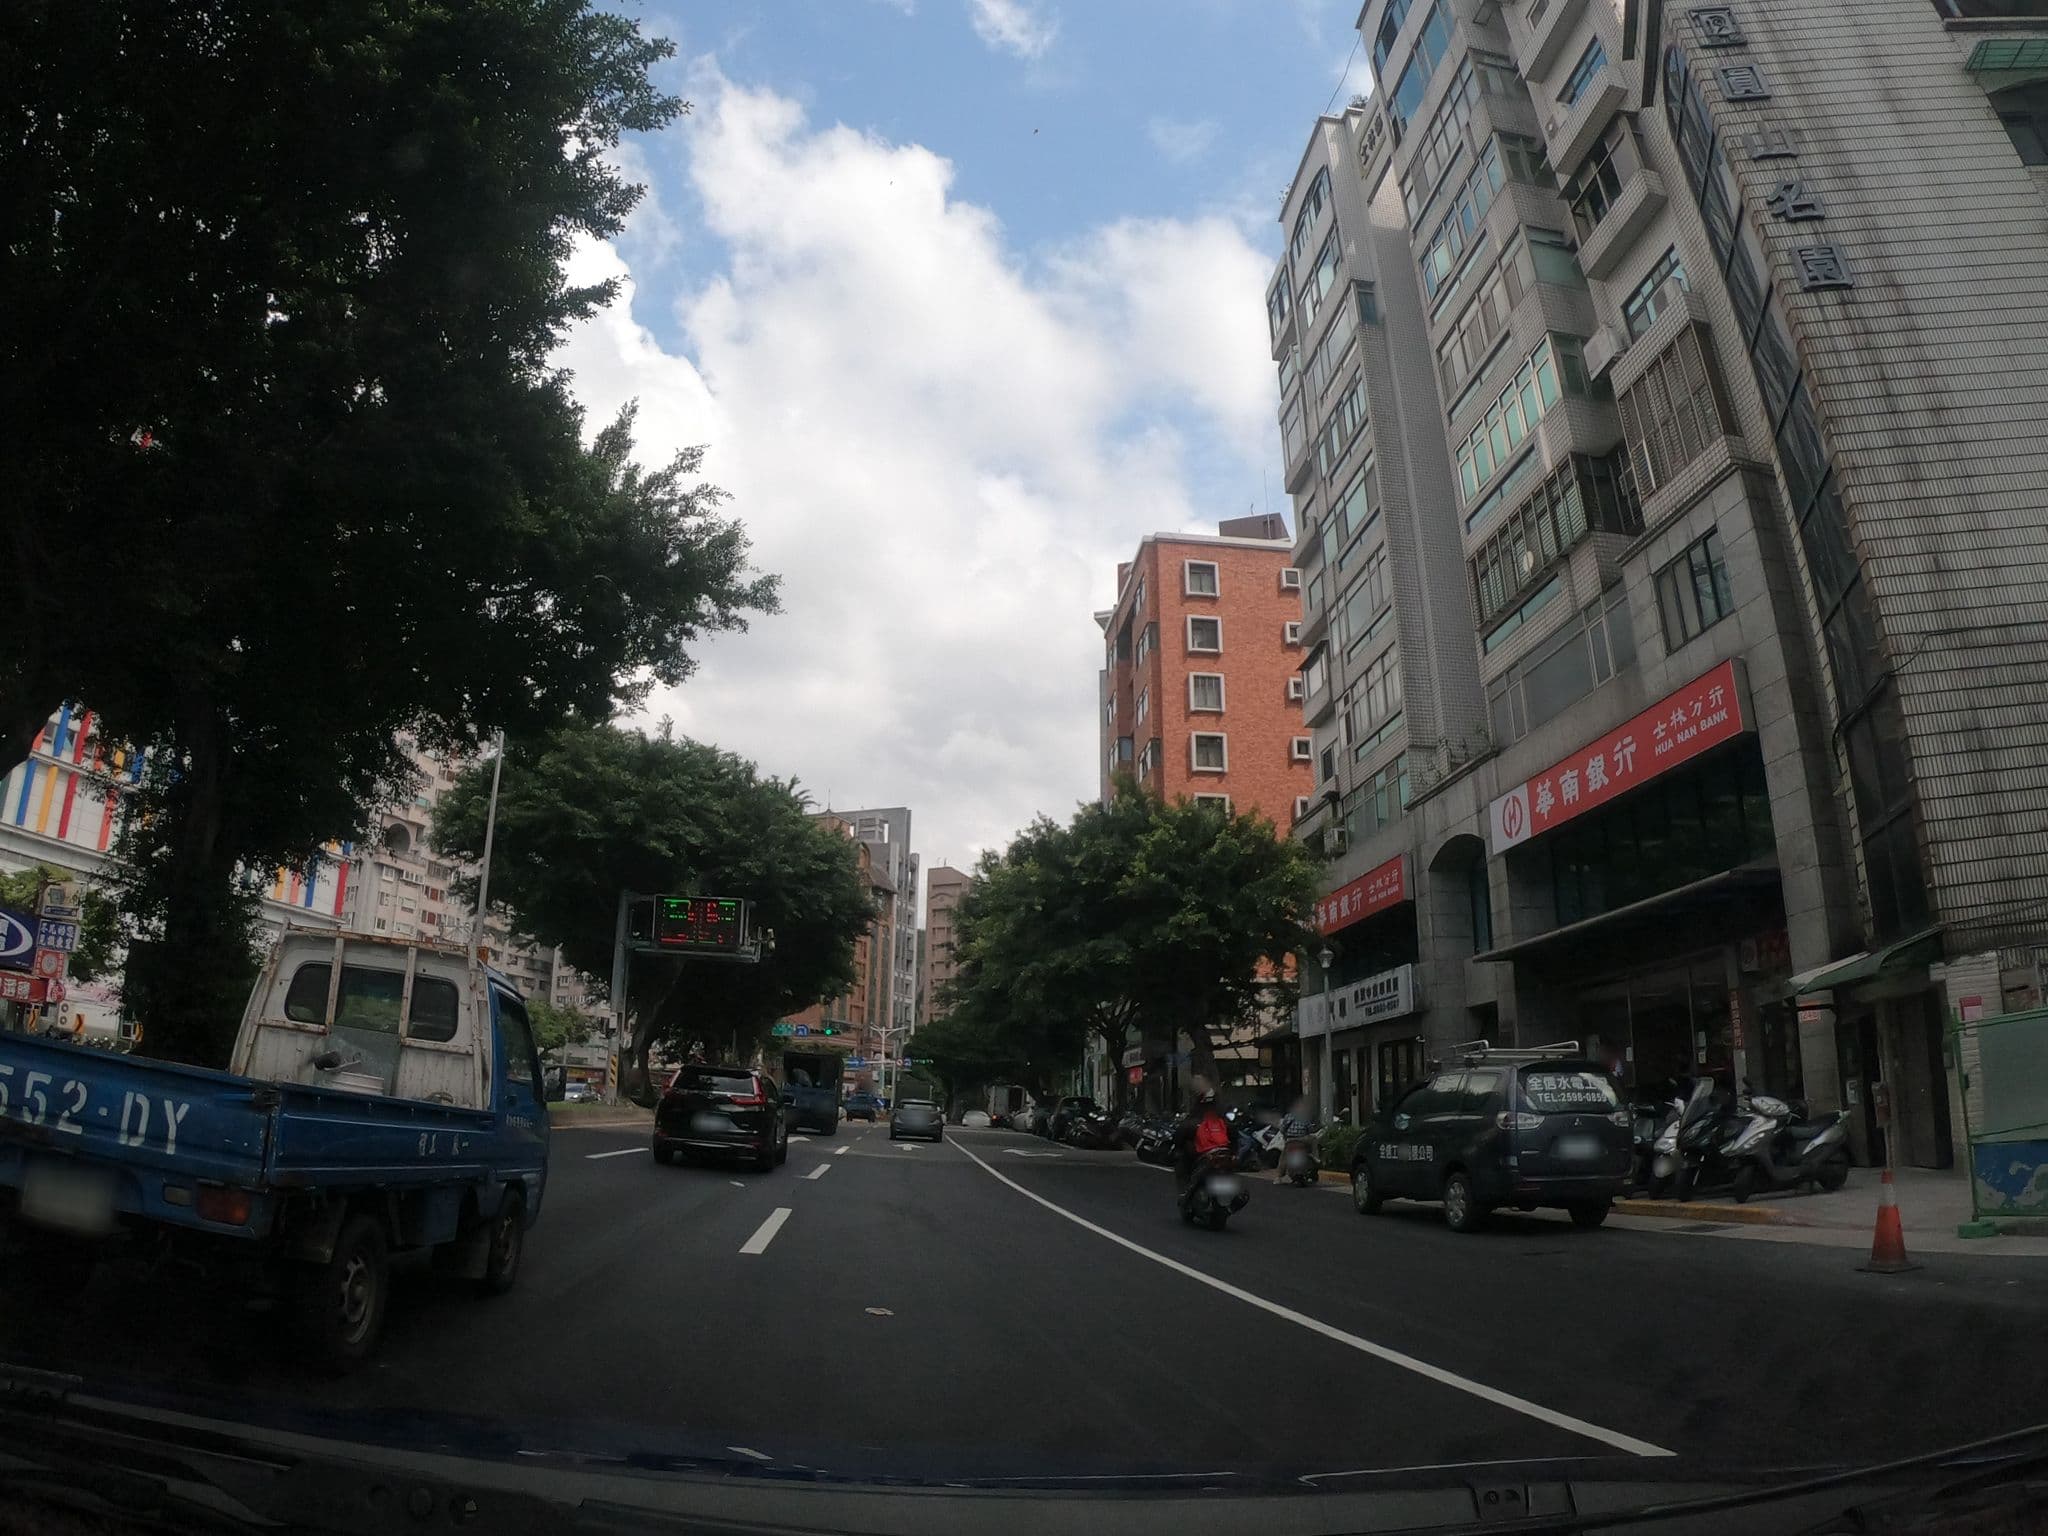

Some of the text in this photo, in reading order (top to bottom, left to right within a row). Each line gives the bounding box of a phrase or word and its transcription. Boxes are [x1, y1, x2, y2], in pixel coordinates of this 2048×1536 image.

[1653, 685, 1724, 739] 士林分行
[1655, 707, 1728, 756] HUA NAN BANK
[1536, 735, 1637, 820] 華南銀行
